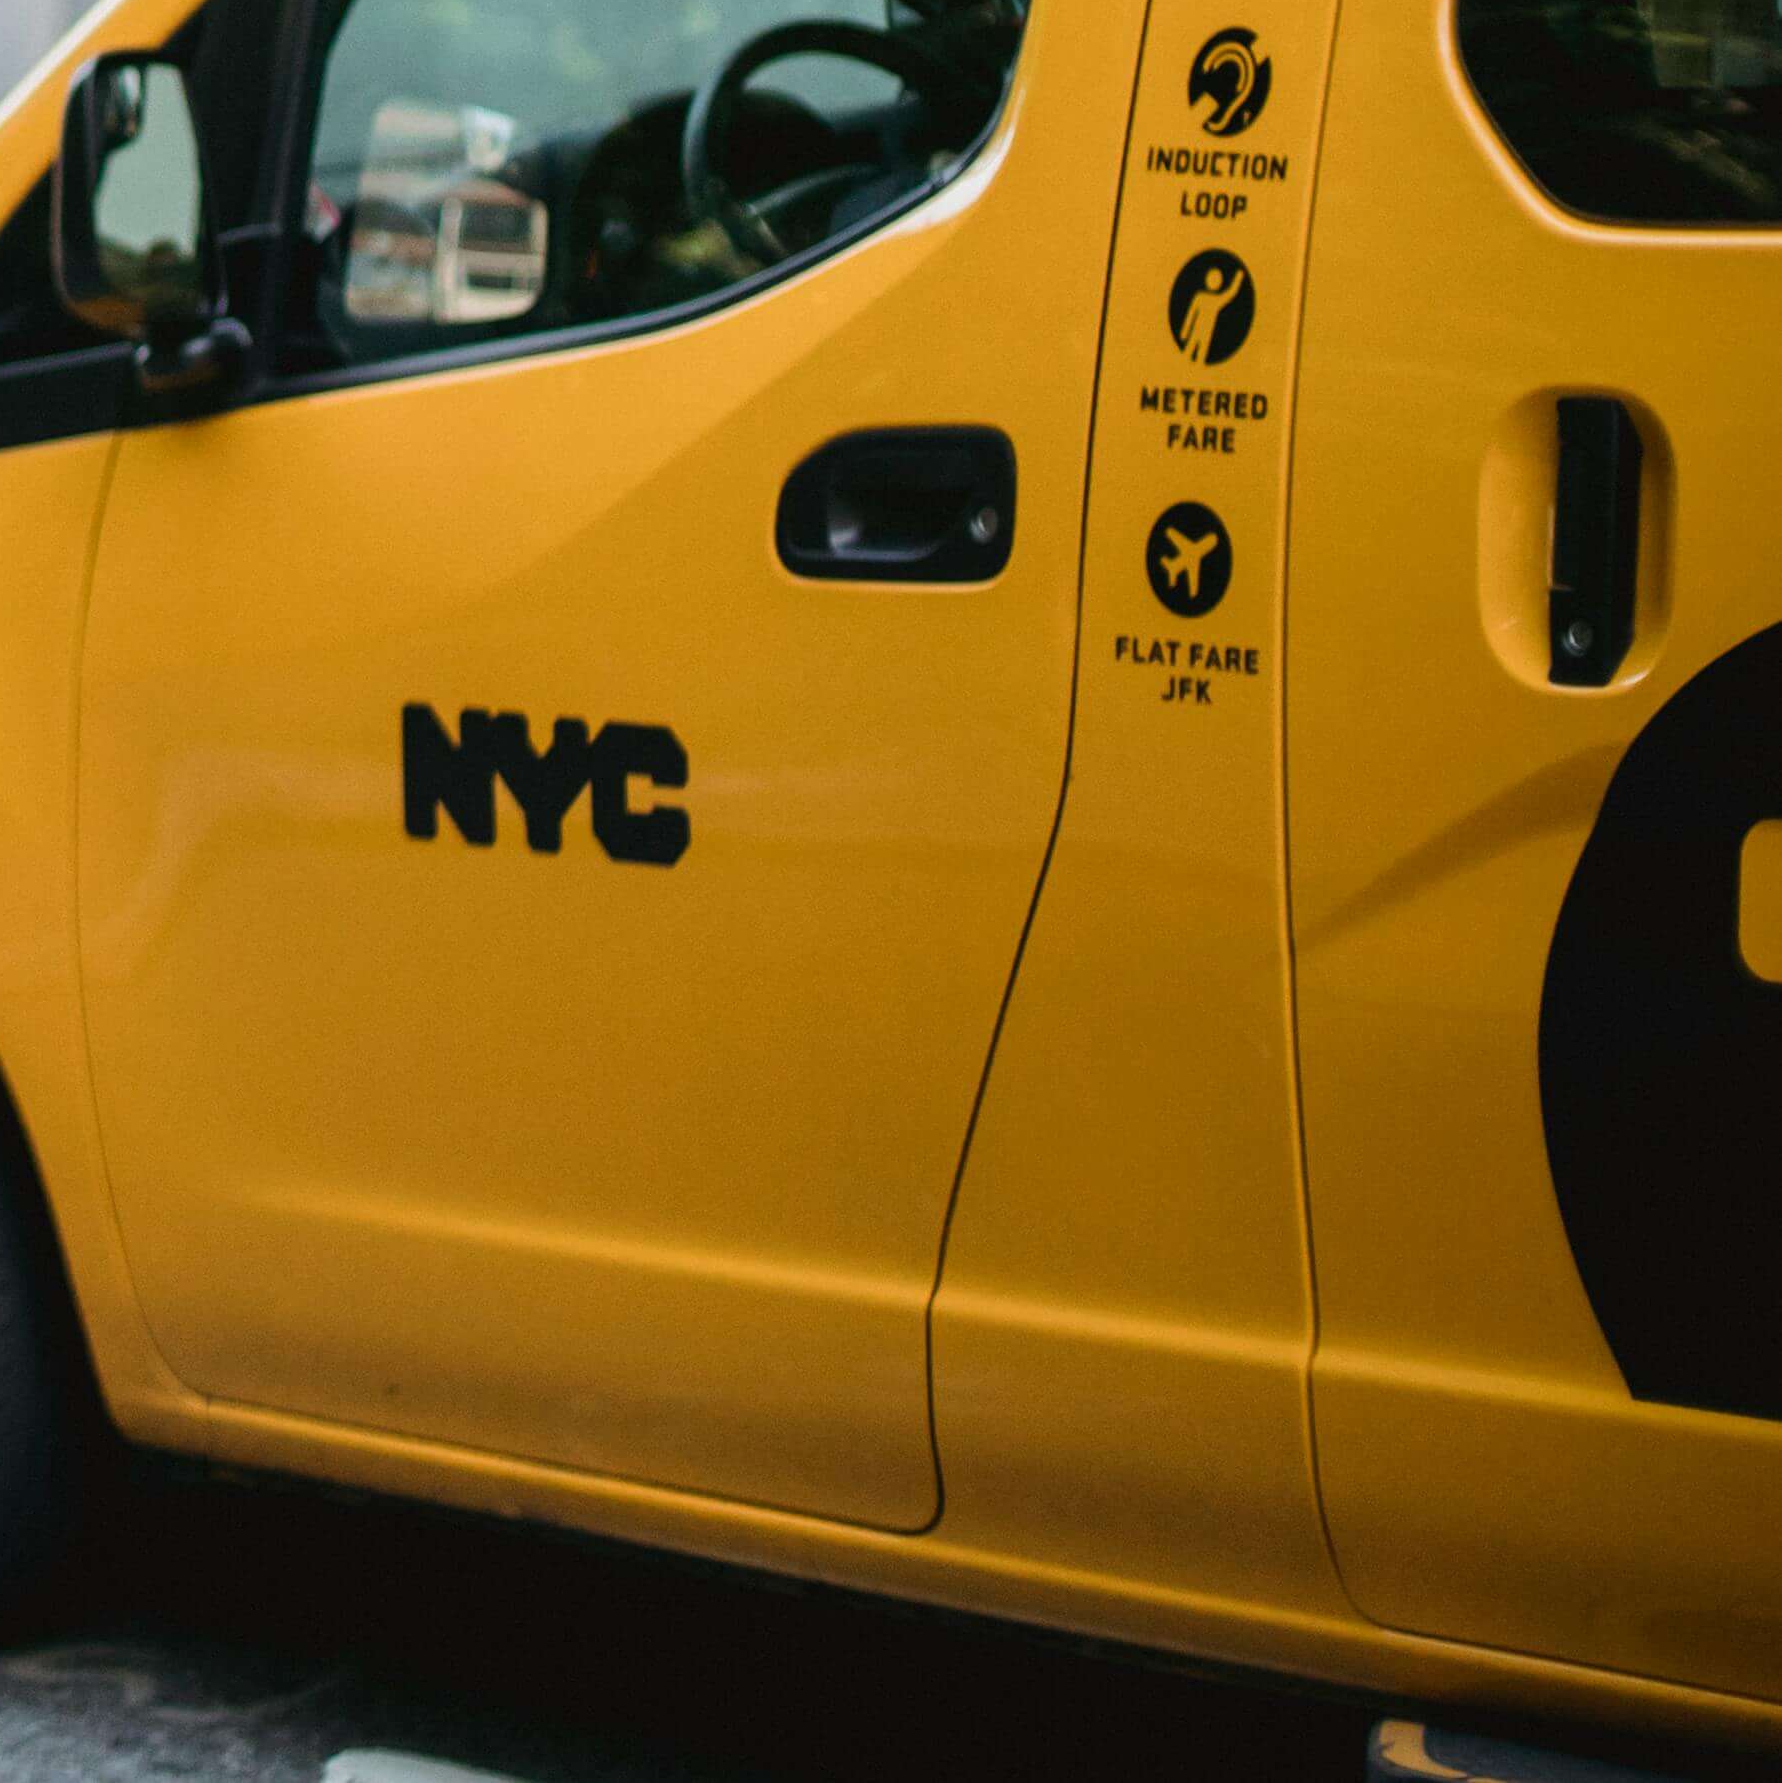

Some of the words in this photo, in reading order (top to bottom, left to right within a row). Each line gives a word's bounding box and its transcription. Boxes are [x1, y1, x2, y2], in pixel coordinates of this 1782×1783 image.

[1148, 148, 1288, 180] INDUCTION
[1180, 191, 1248, 219] LOOP
[1141, 386, 1268, 420] METERED
[1168, 424, 1236, 454] FARE
[1115, 636, 1181, 666] FLAT
[1190, 643, 1259, 675] FARE
[1162, 677, 1212, 704] JFK
[401, 702, 691, 867] NYC
